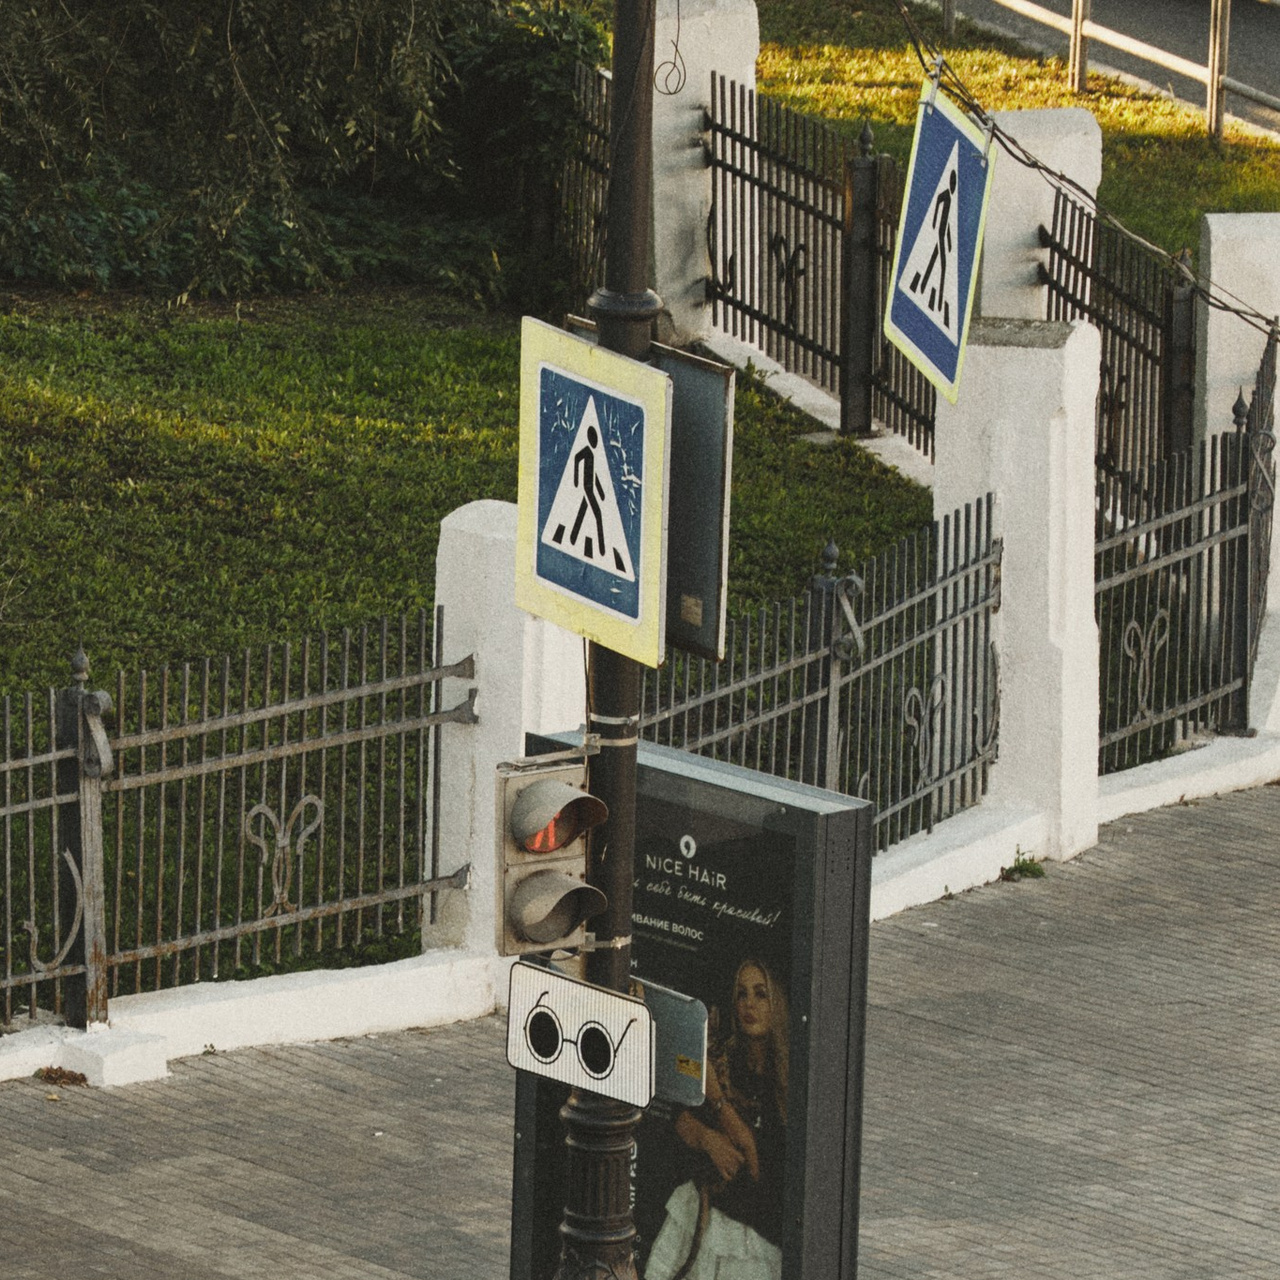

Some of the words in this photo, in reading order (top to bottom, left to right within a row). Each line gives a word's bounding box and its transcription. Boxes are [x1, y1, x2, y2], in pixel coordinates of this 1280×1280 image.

[645, 854, 683, 876] NICE
[677, 885, 707, 906] быть
[672, 923, 704, 940] ВОЛОС
